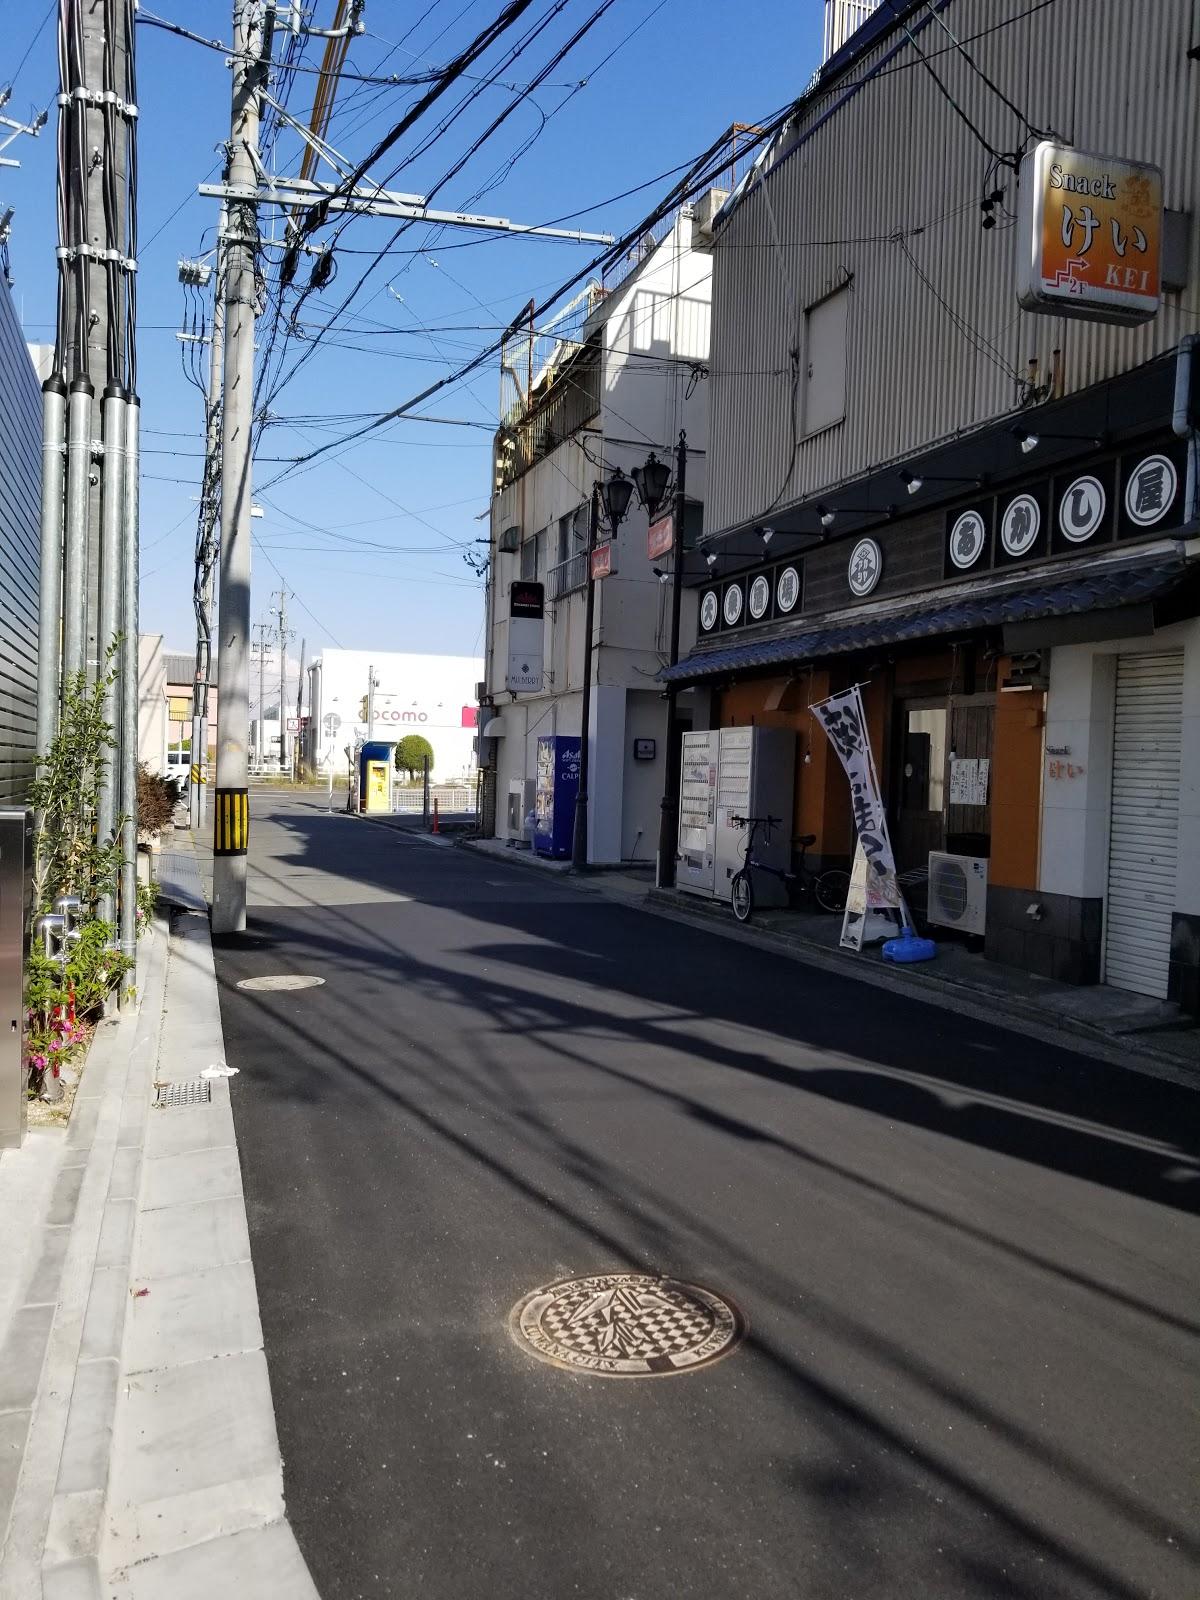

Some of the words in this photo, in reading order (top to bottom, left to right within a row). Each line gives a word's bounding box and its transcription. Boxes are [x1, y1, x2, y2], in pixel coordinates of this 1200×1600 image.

[1049, 164, 1117, 200] Snack
[1061, 203, 1148, 257] けい
[1069, 278, 1088, 295] 2F
[1105, 263, 1151, 291] KEI
